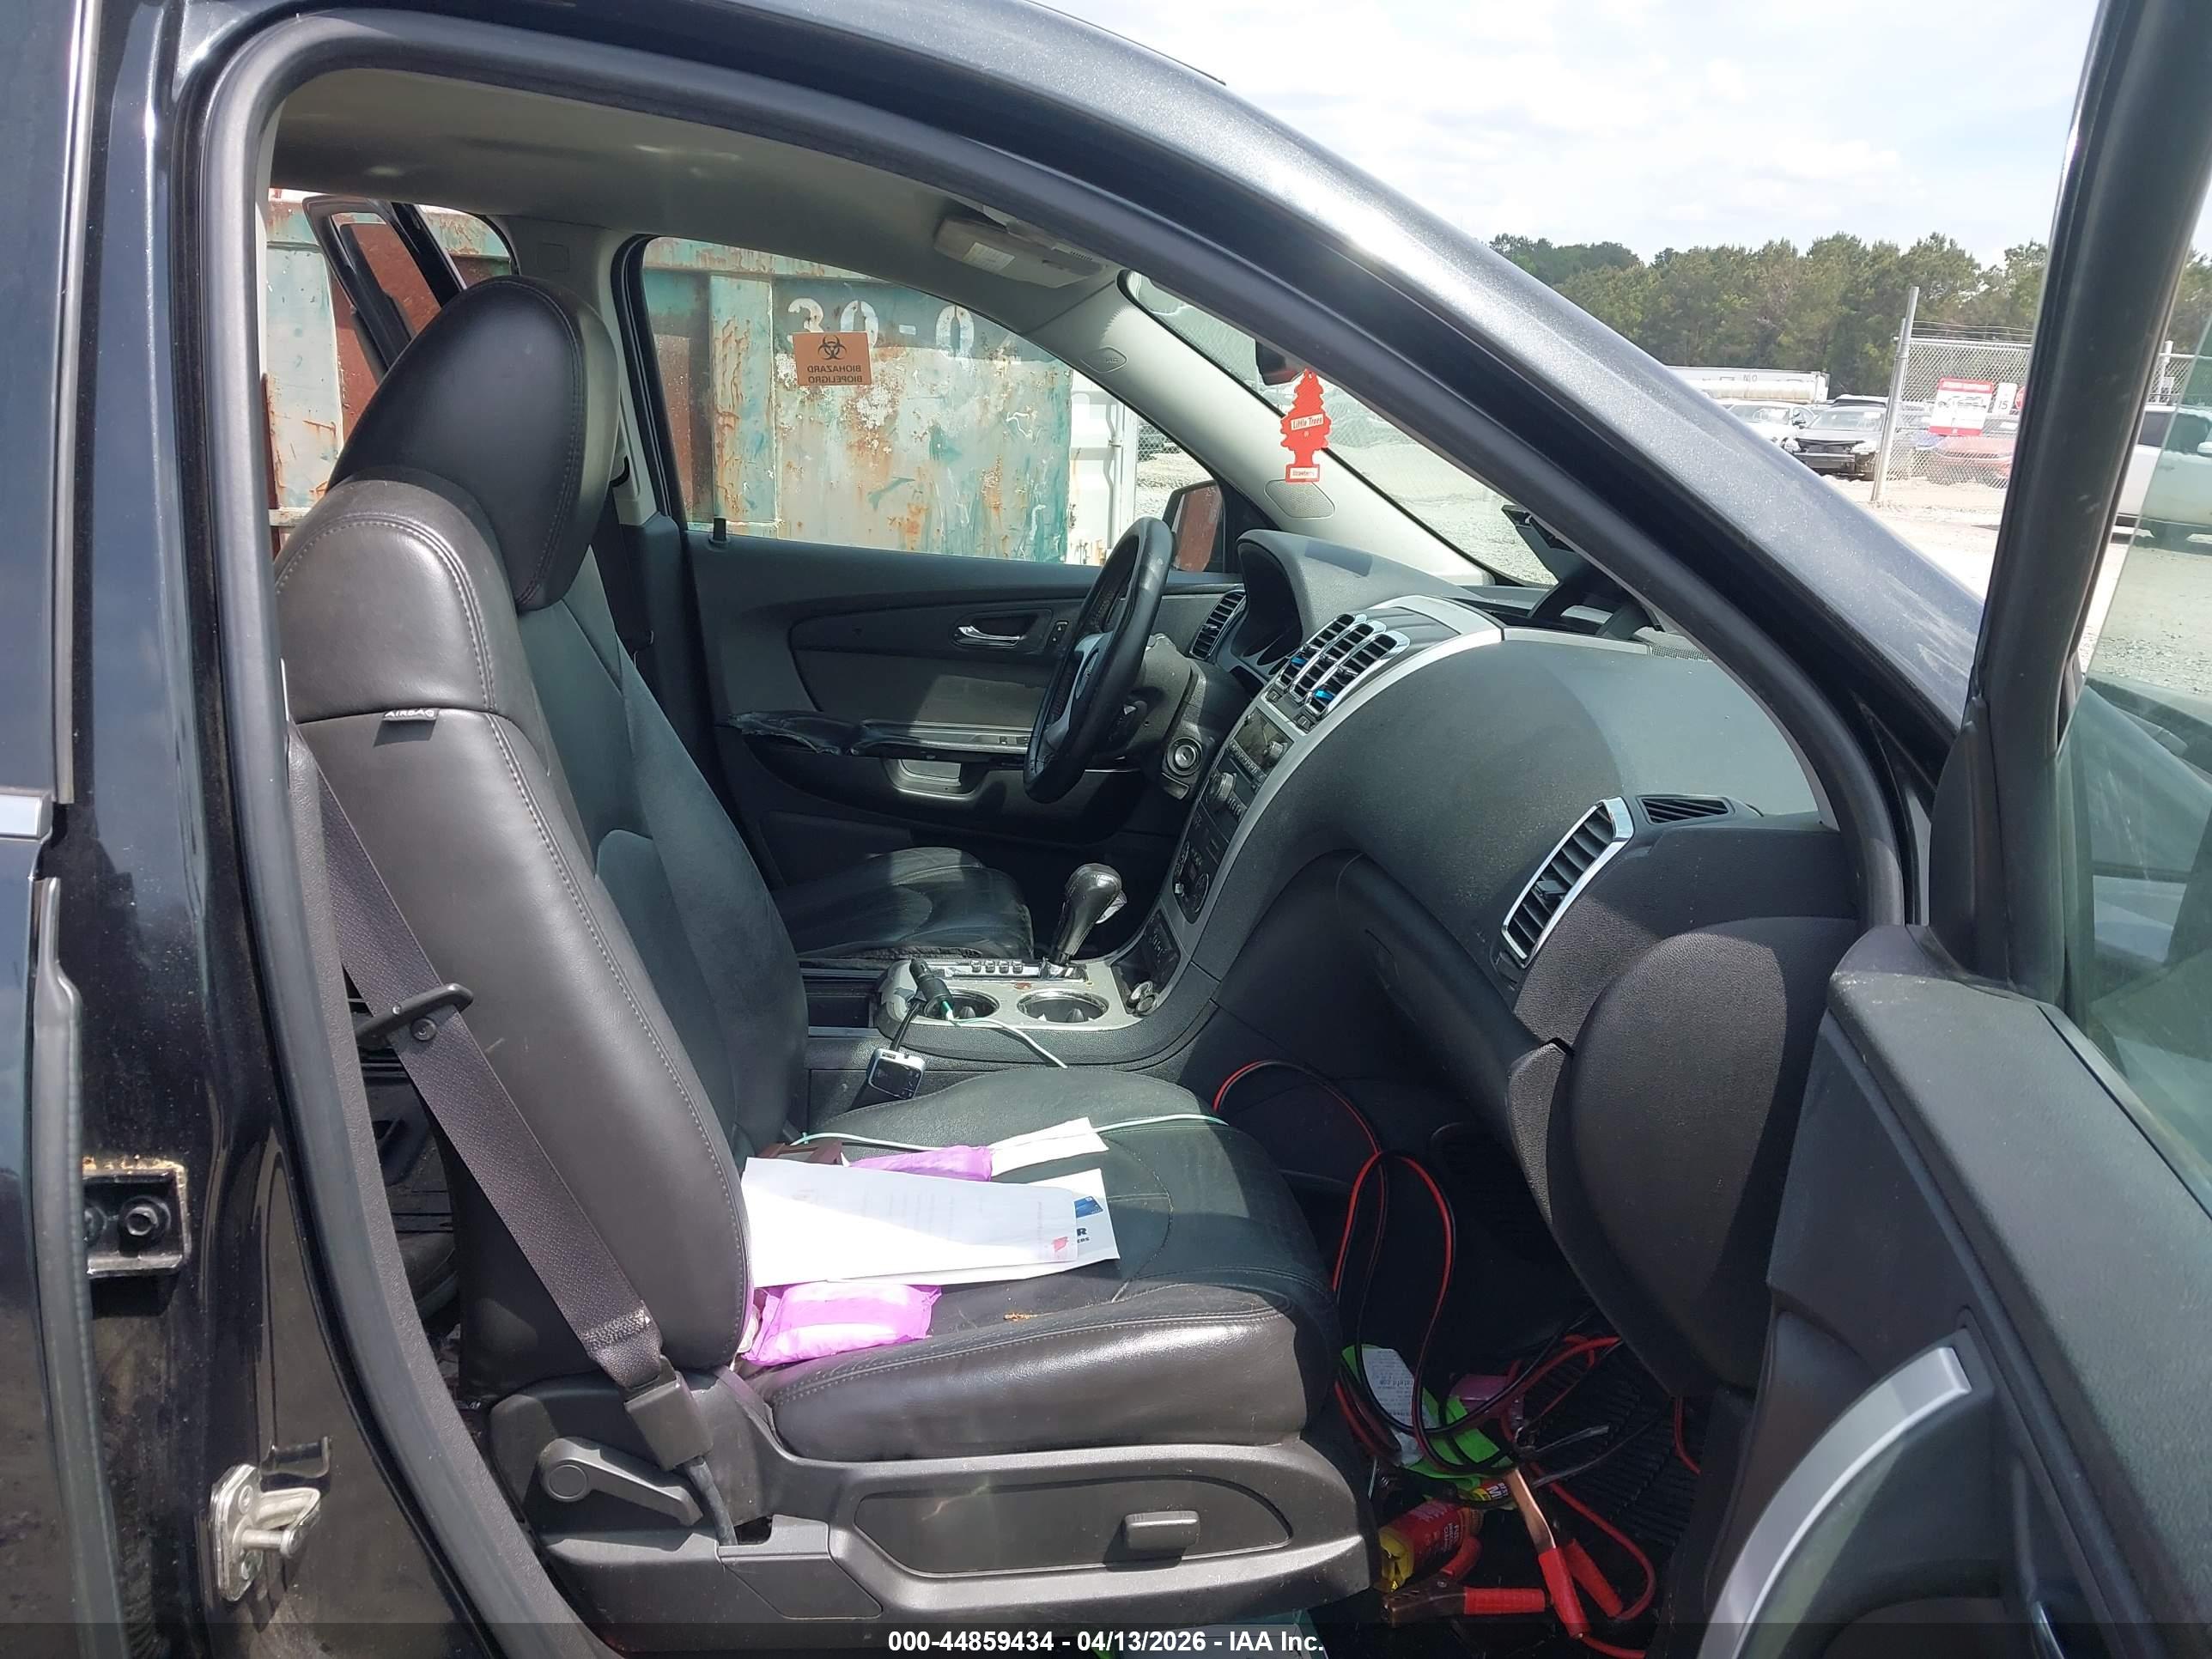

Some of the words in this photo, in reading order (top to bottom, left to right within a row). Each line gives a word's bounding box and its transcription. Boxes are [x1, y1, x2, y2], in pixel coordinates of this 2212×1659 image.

[1998, 399, 2008, 410] 15
[1293, 418, 1308, 429] Little
[1308, 416, 1322, 426] Trees
